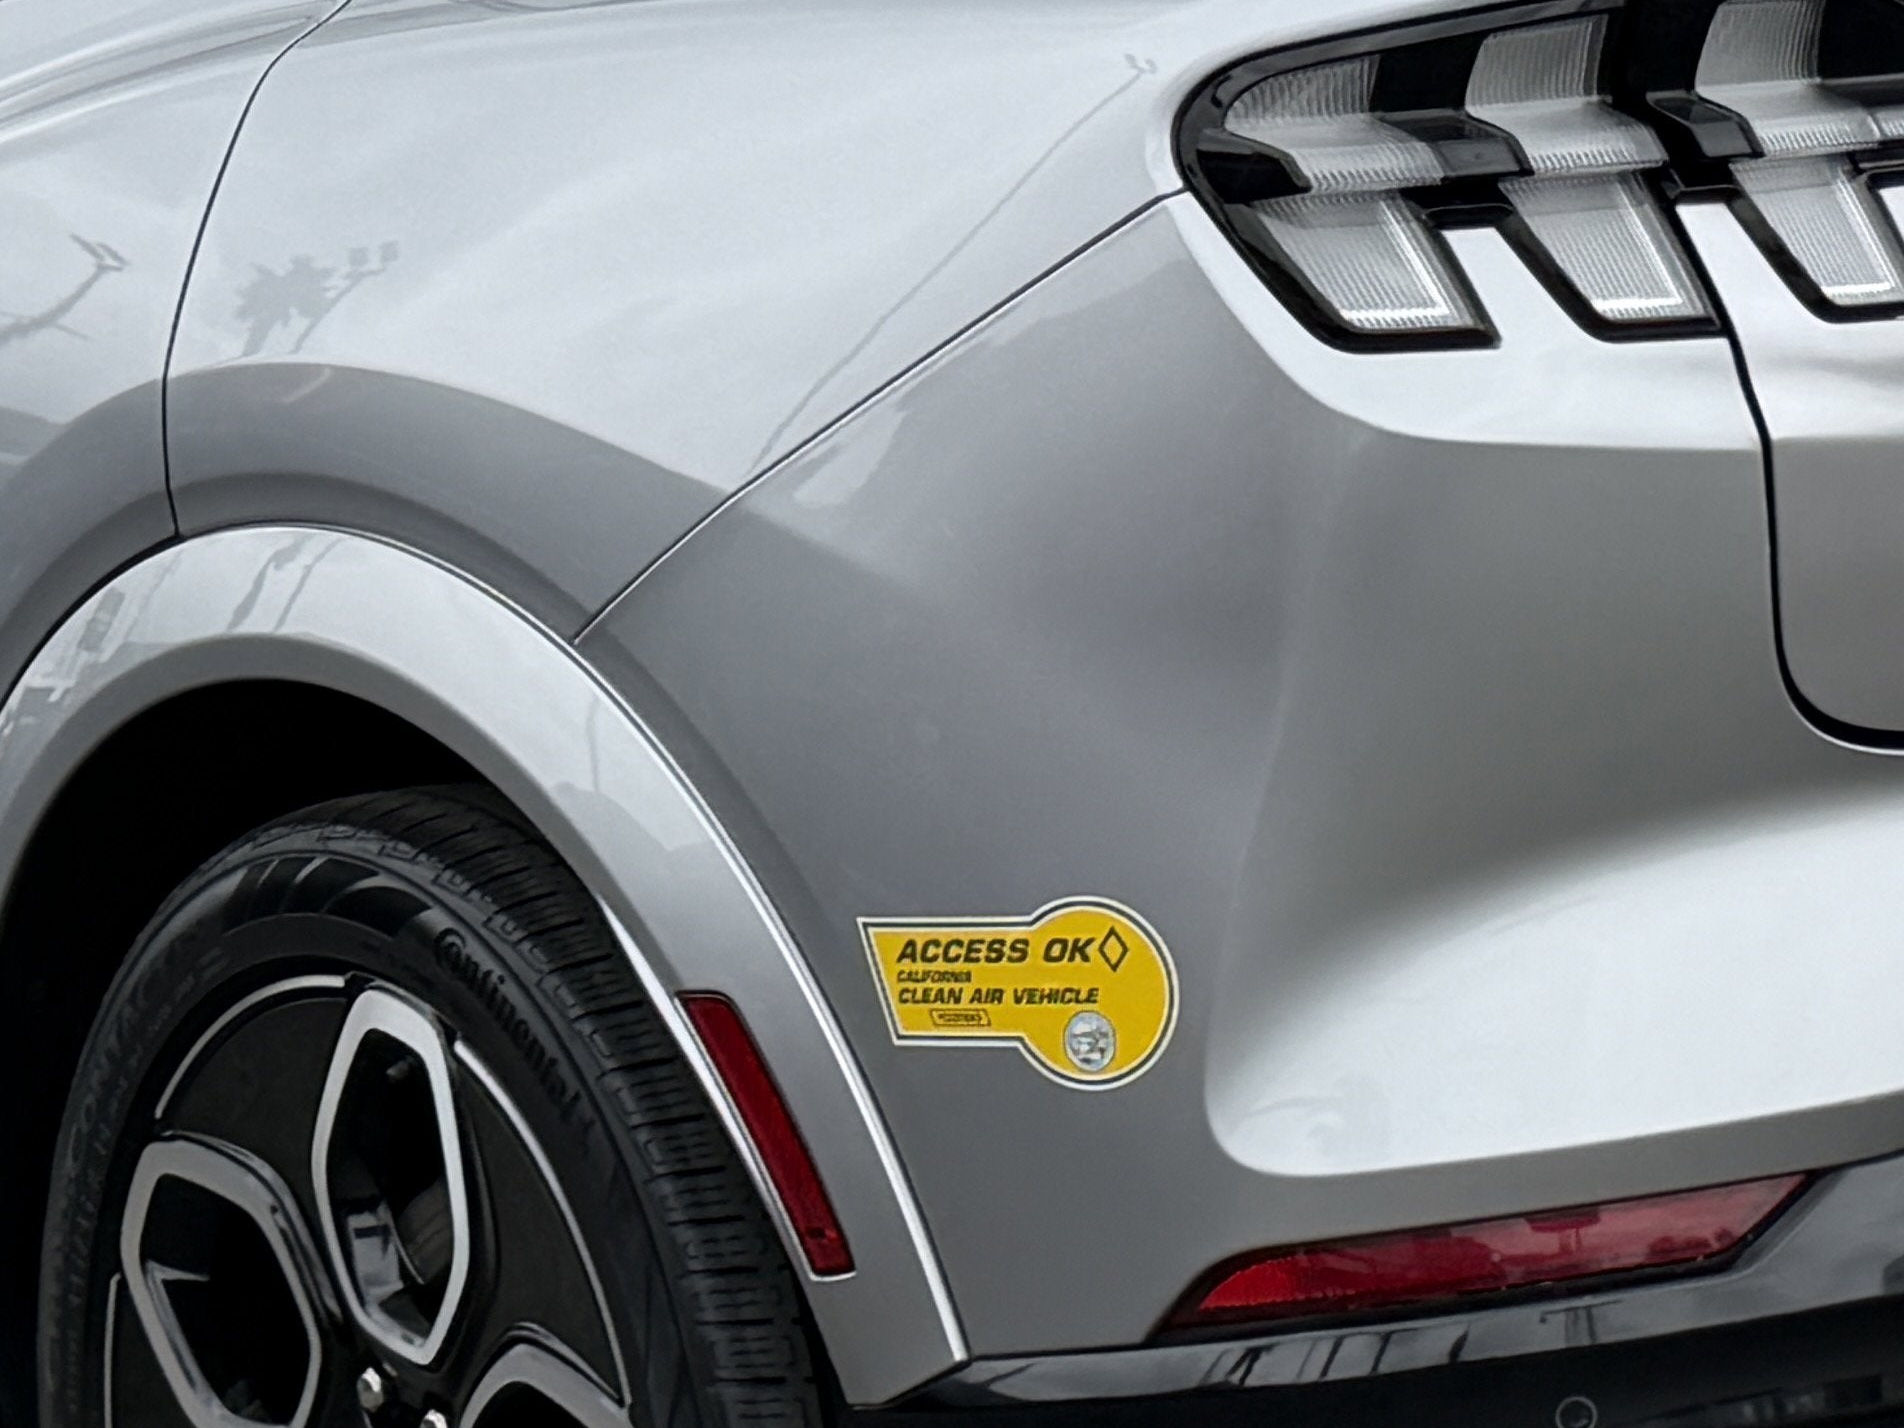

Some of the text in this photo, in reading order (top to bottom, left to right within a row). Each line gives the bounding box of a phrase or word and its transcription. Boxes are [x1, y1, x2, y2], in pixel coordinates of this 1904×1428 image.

[896, 937, 1097, 964] ACCESS OK
[897, 970, 972, 984] CALIFORNIA
[898, 987, 1101, 1005] CLEAN AIR VEHICLE
[433, 927, 581, 1124] Continental
